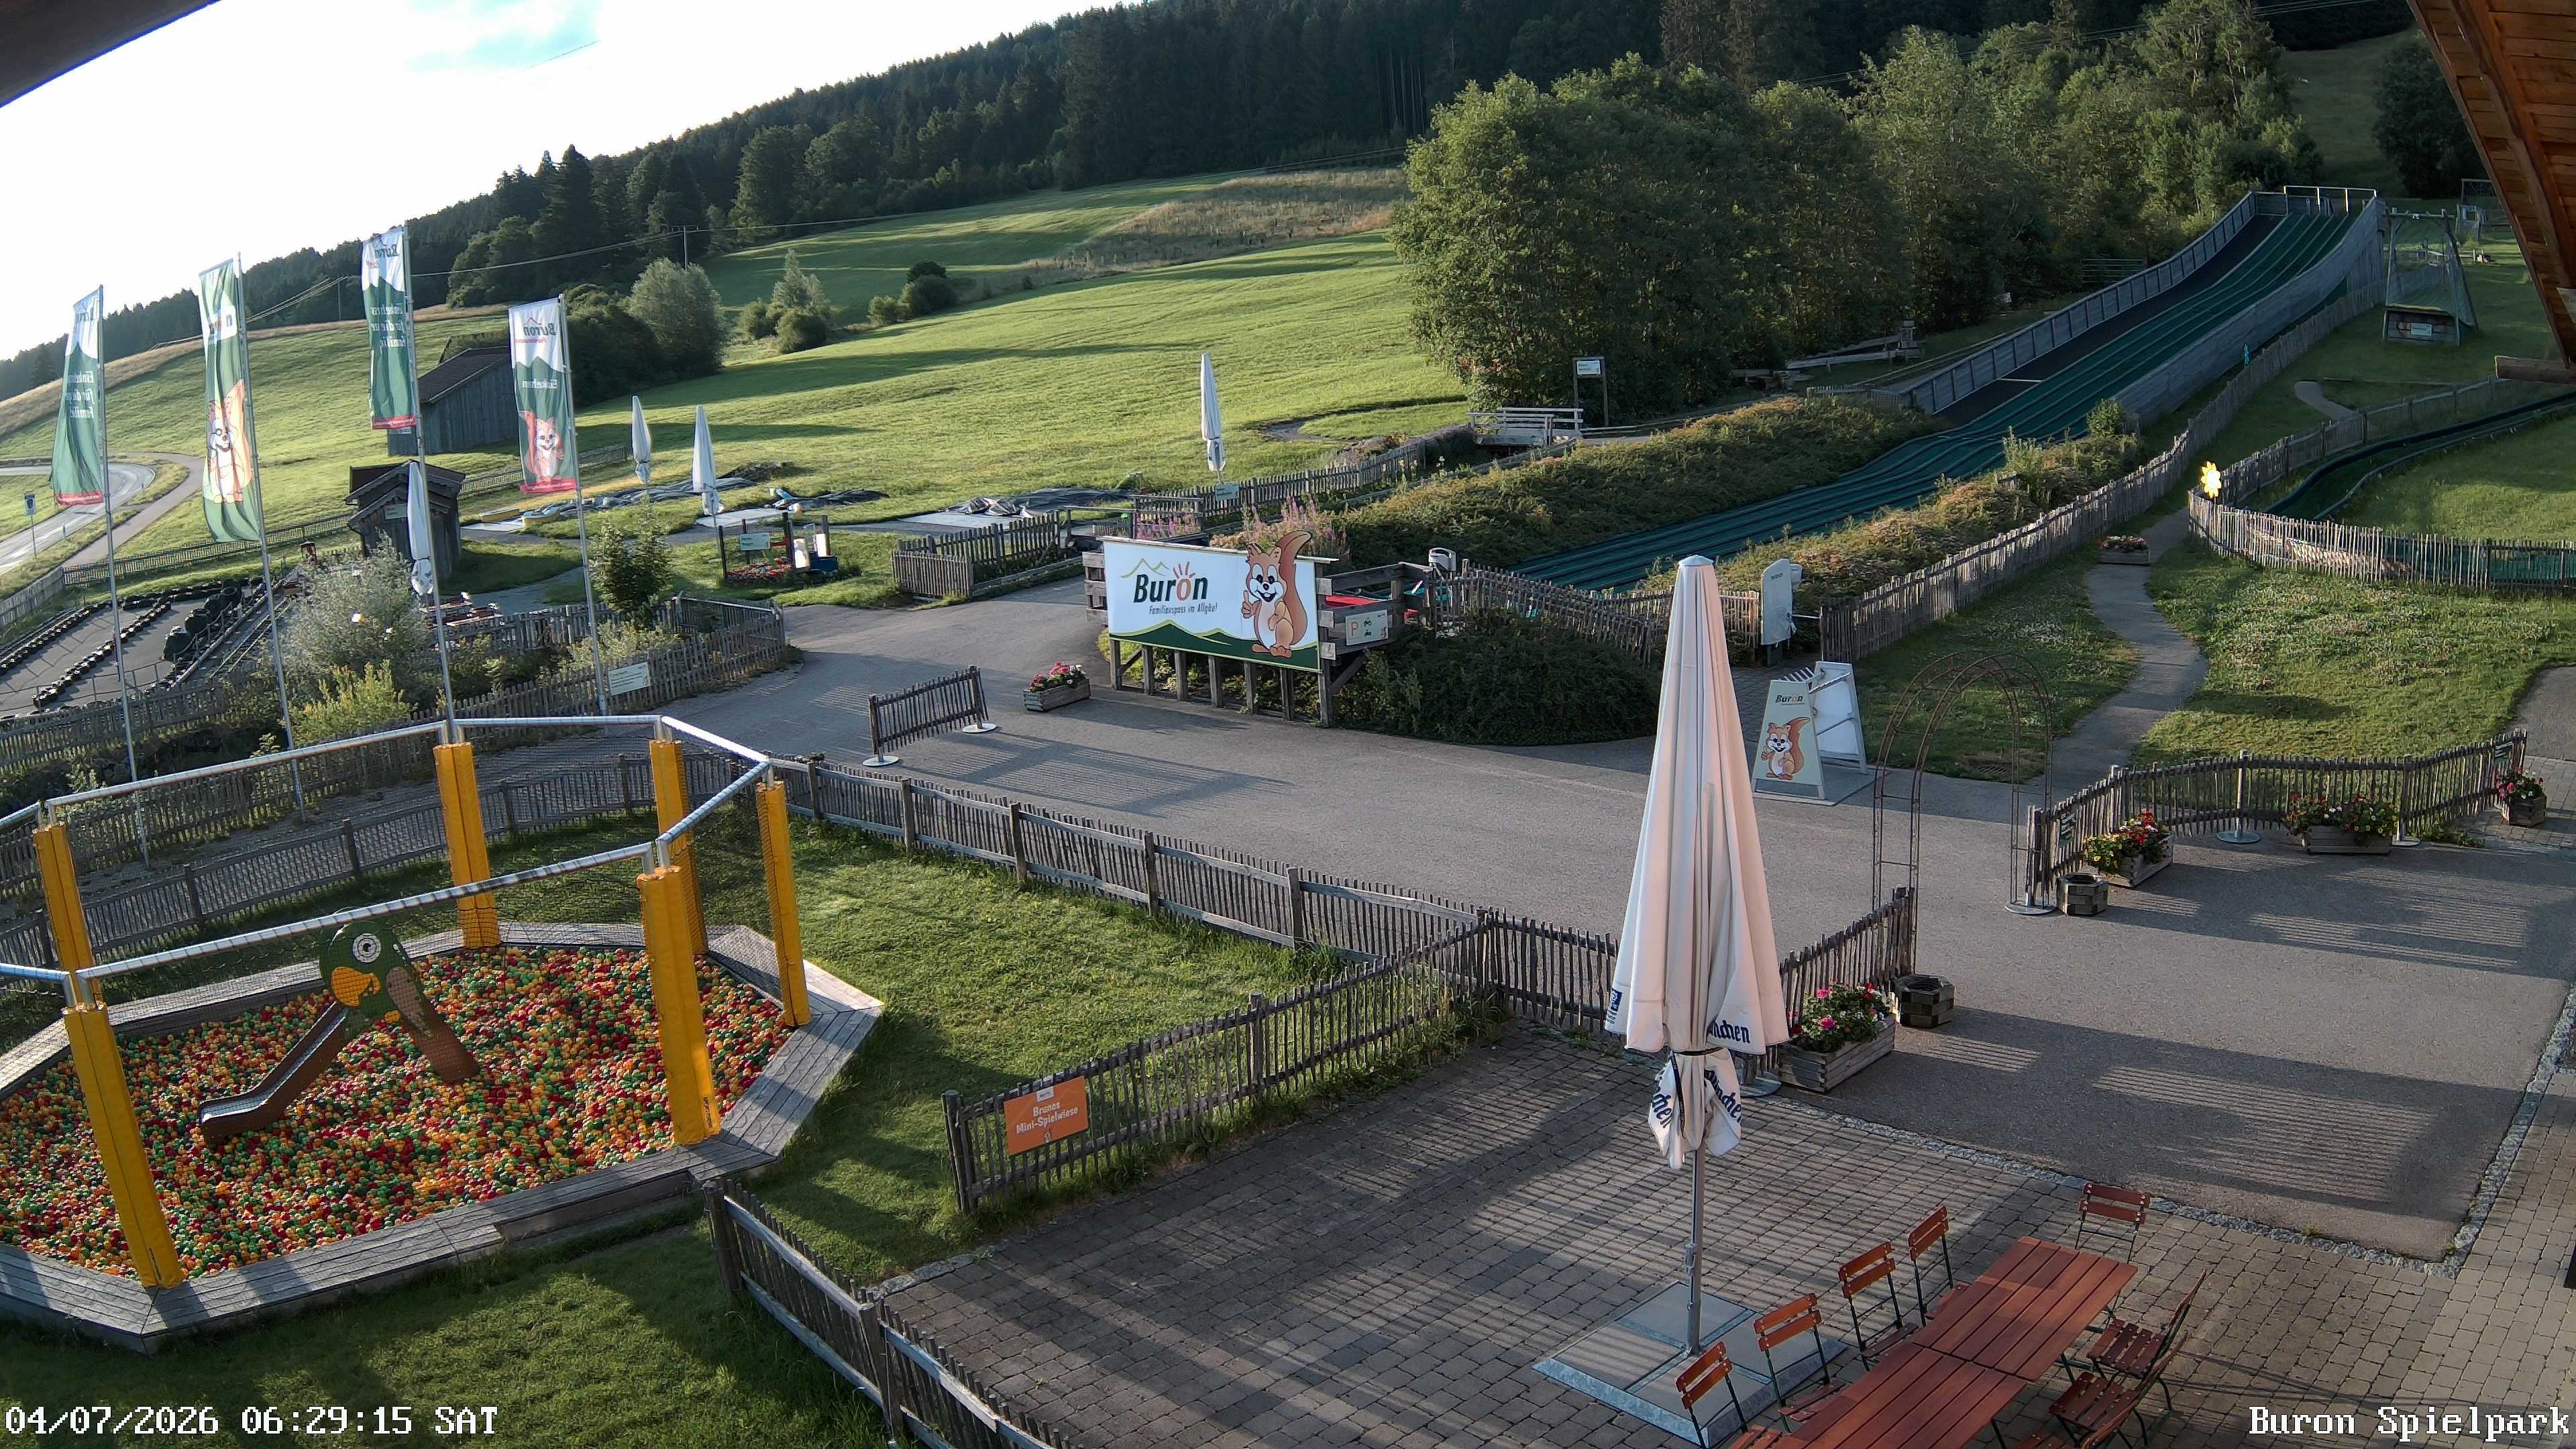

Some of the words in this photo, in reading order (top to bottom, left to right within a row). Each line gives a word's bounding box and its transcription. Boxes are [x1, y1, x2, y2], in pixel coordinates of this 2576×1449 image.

[1134, 574, 1208, 603] Buron
[1351, 621, 1358, 636] P
[1775, 694, 1804, 703] Buron
